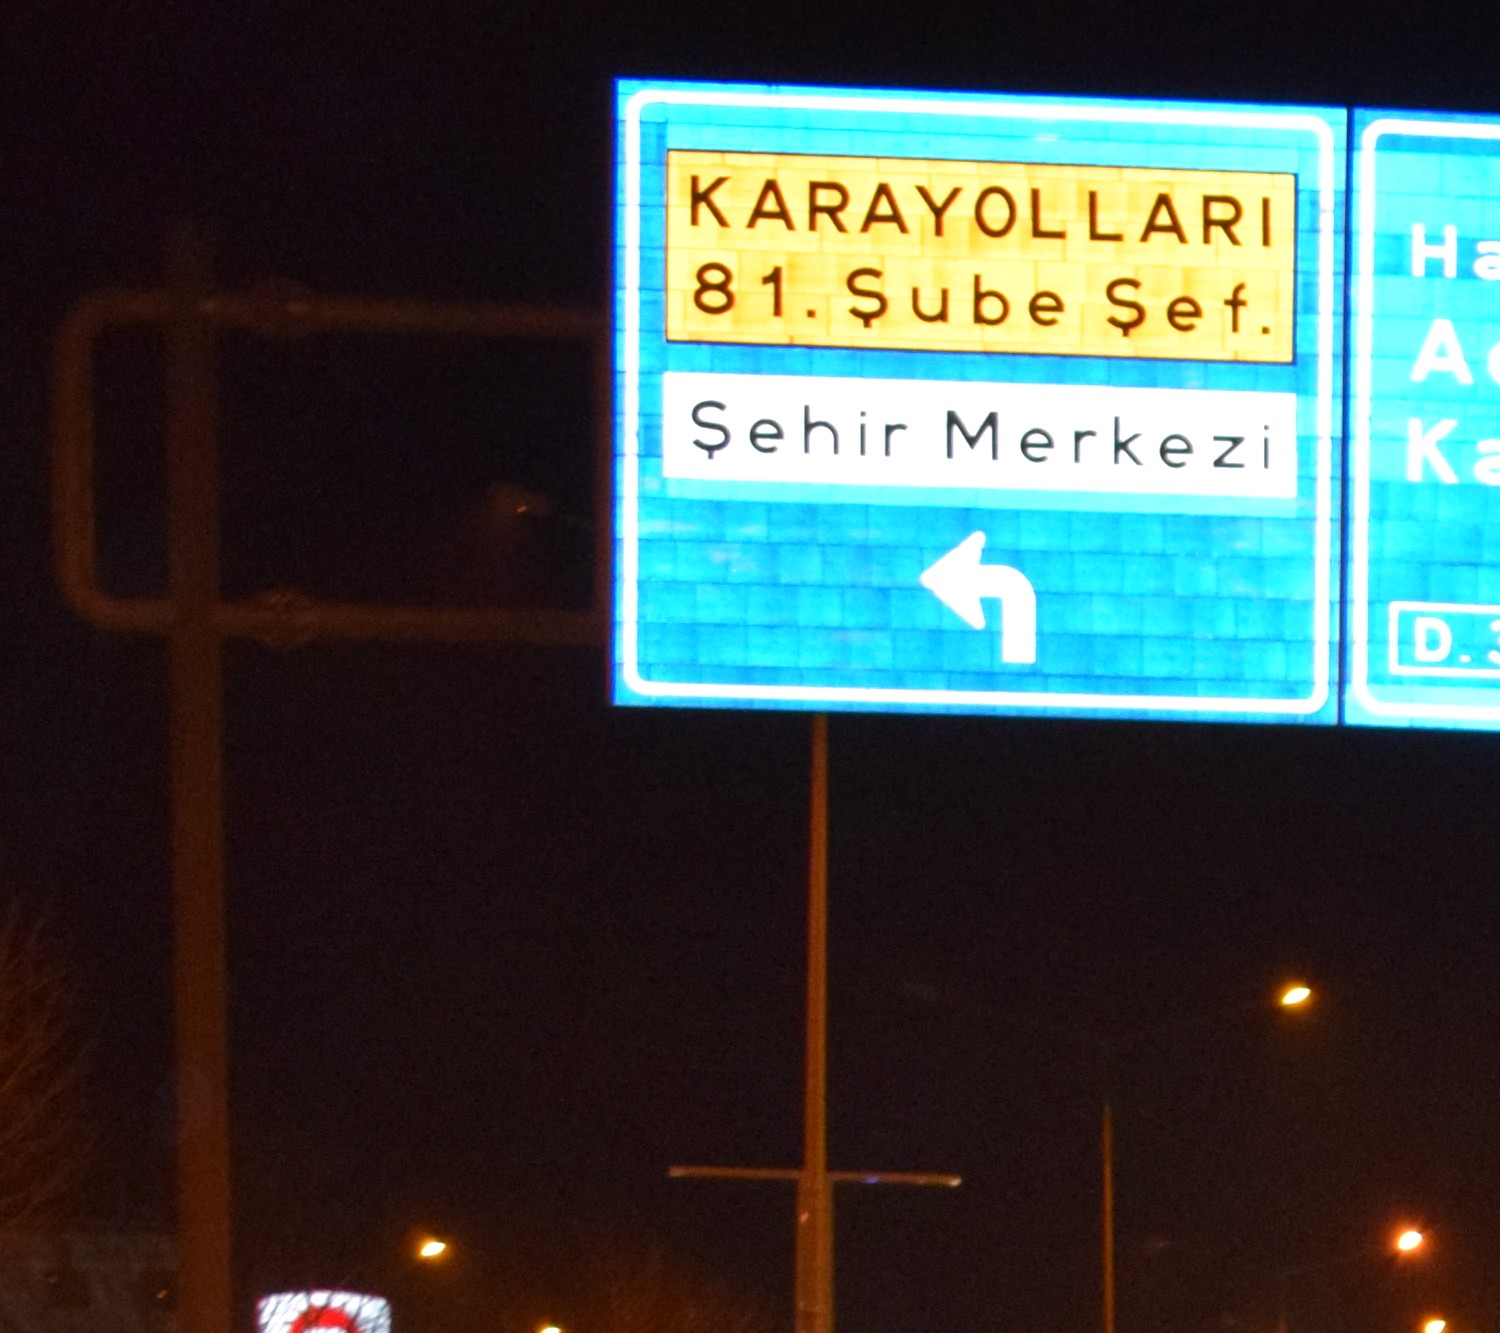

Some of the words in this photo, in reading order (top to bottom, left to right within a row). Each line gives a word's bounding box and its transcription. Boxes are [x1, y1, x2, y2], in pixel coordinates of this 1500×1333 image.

[690, 174, 1271, 247] KARAYOLLARI
[693, 262, 817, 319] 81.
[846, 267, 1065, 329] Şube
[1106, 277, 1270, 337] Şef.
[691, 400, 908, 460] Şehir
[946, 410, 1269, 469] Merkezi
